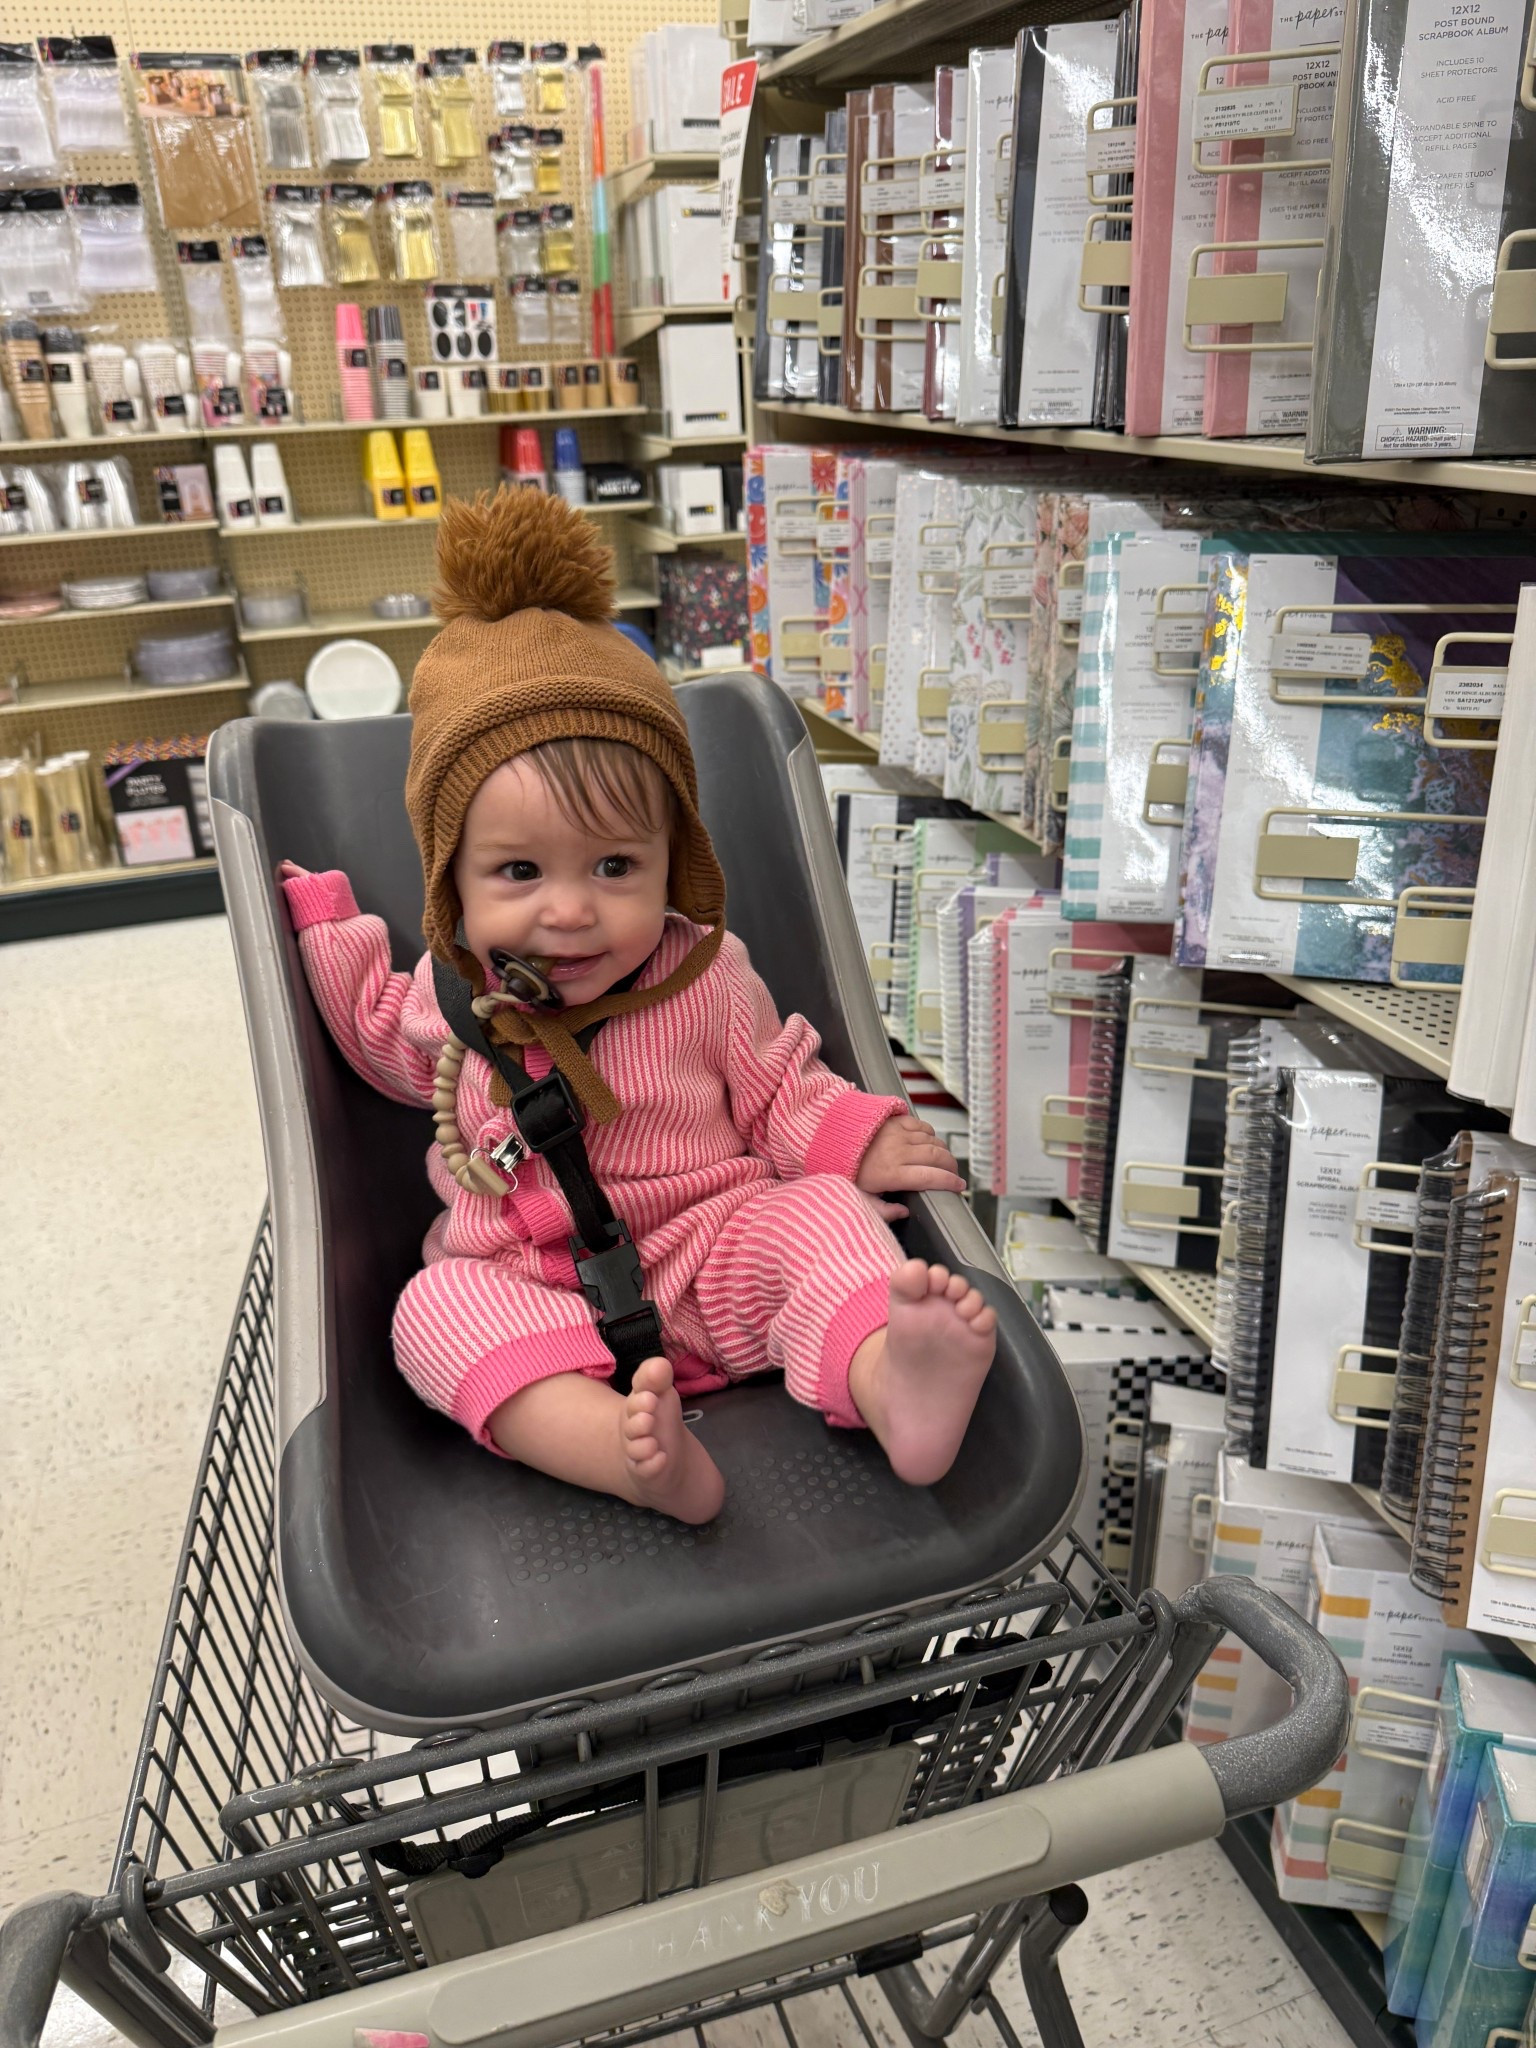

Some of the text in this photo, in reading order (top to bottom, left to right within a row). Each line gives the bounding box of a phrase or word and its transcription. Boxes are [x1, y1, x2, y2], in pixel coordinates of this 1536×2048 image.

[1452, 4, 1481, 15] 12X12
[1280, 16, 1294, 24] THE
[1295, 6, 1337, 30] paper
[1434, 16, 1495, 29] POST BOUND
[1205, 26, 1229, 46] pap
[1418, 26, 1509, 41] SCRAPBOOK ALBUM
[1306, 60, 1330, 70] 12X12
[1436, 56, 1485, 67] INCLUDES 10
[1292, 70, 1339, 82] POST BOUN
[1420, 66, 1498, 79] SHEET PROTECTORS
[1299, 82, 1325, 91] PBOOK
[1436, 95, 1477, 104] ACID FREE
[1298, 105, 1326, 114] NCLUDES
[1462, 121, 1485, 129] SPINE
[1413, 131, 1492, 143] ACCEPT ADDITIONAL
[1452, 142, 1478, 151] PAGES
[1304, 168, 1330, 176] ADDITIO
[1408, 426, 1447, 435] WARNING:
[1309, 1126, 1346, 1141] paper
[1386, 1609, 1419, 1624] paper
[796, 1861, 880, 1922] YOU
